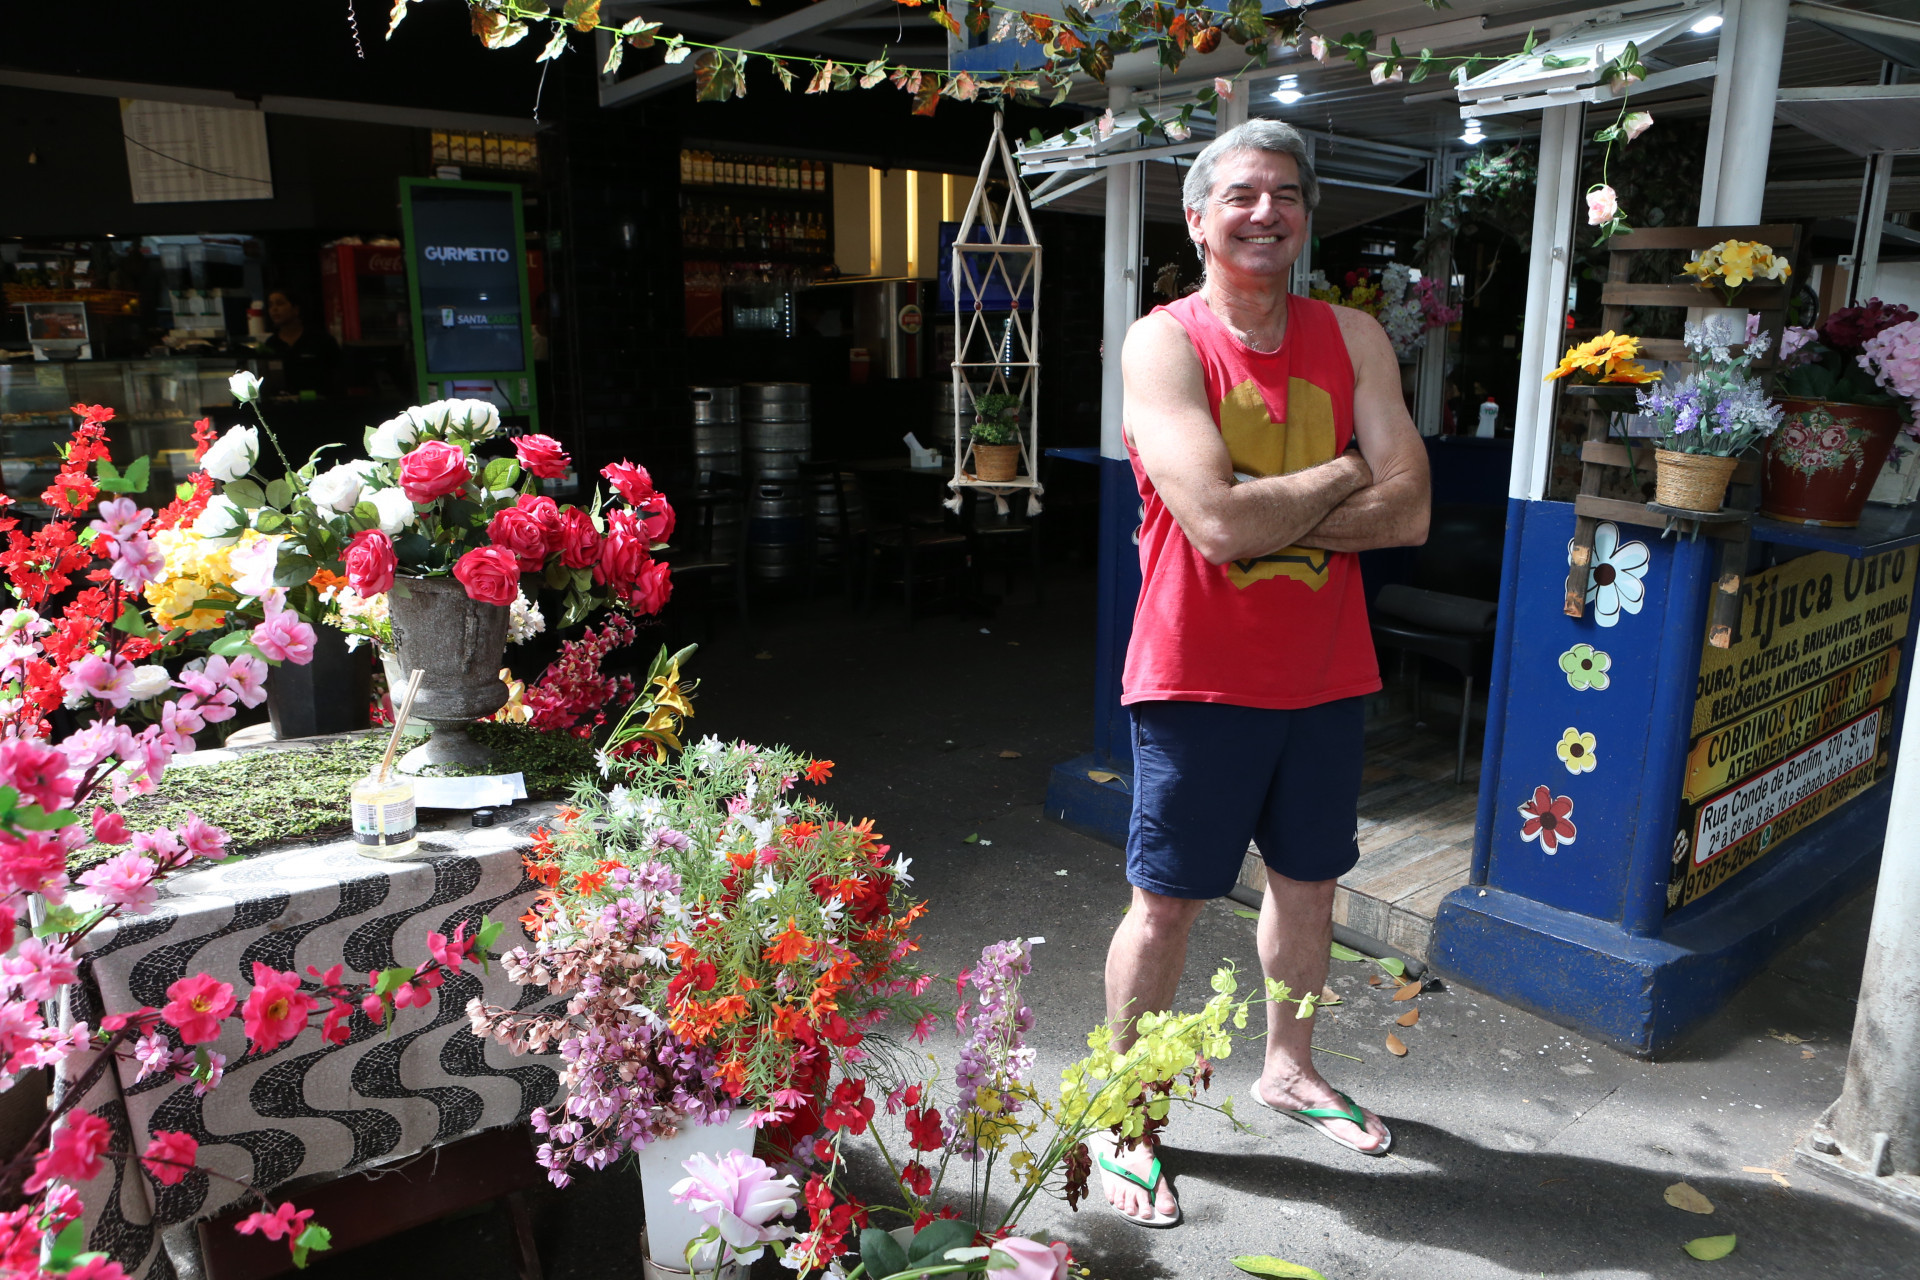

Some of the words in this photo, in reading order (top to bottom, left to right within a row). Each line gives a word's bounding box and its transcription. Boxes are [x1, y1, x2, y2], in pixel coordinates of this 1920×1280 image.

[424, 245, 510, 264] GURMETTO
[1730, 573, 1833, 650] Tijuca
[1844, 549, 1906, 602] Ouro
[1740, 639, 1800, 682] CAUTELAS,
[1802, 613, 1862, 656] BRILHANTES,
[1864, 594, 1908, 630] PRATARIAS,
[1708, 704, 1786, 768] COBRIMOS
[1789, 672, 1851, 729] QUALQUER
[1853, 653, 1890, 694] OFERTA
[1711, 677, 1772, 724] RELÓGIOS
[1773, 655, 1823, 695] ANTIGOS,
[1825, 641, 1852, 672] JÓIAS
[1853, 635, 1868, 659] EM
[1868, 623, 1893, 651] GERAL
[1702, 803, 1728, 833] Rua
[1731, 778, 1768, 816] Conde
[1770, 768, 1784, 794] de
[1786, 748, 1823, 786] Bonfim,
[1825, 733, 1843, 762] 370
[1861, 713, 1877, 740] 408
[1726, 726, 1803, 783] ATENDEMOS
[1804, 716, 1821, 740] EM
[1821, 689, 1872, 731] DOMICÍLIO
[1721, 826, 1728, 848] à
[1742, 813, 1753, 835] de
[1755, 806, 1763, 827] 8
[1764, 800, 1775, 822] às
[1777, 790, 1788, 813] 18
[1788, 790, 1794, 806] e
[1796, 770, 1825, 801] sábado
[1826, 762, 1837, 783] de
[1837, 756, 1844, 775] 8
[1855, 745, 1864, 765] 14
[1864, 742, 1870, 760] h
[1686, 831, 1762, 900] 97875-2643
[1771, 793, 1823, 842] 2567-5233
